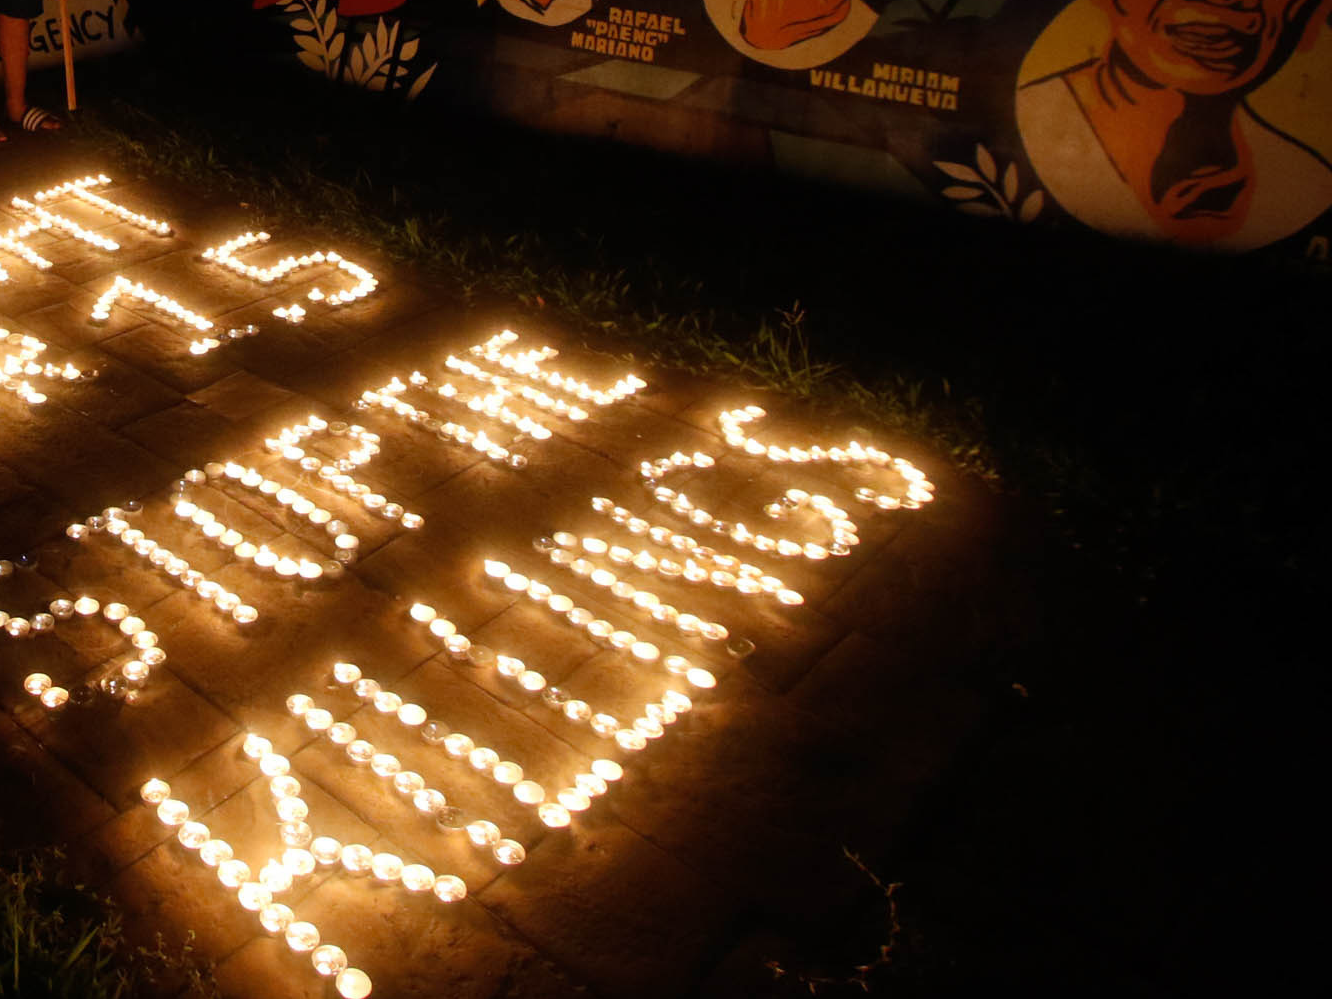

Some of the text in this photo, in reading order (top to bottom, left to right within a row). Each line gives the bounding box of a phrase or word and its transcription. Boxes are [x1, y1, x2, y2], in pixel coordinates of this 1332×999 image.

[608, 6, 686, 35] RAFAEL
[571, 31, 655, 62] MARIANO
[809, 70, 959, 111] VILLANUEVA
[873, 62, 961, 92] MIRIAM
[353, 328, 648, 468] THE
[140, 404, 936, 998] KILLINGS
